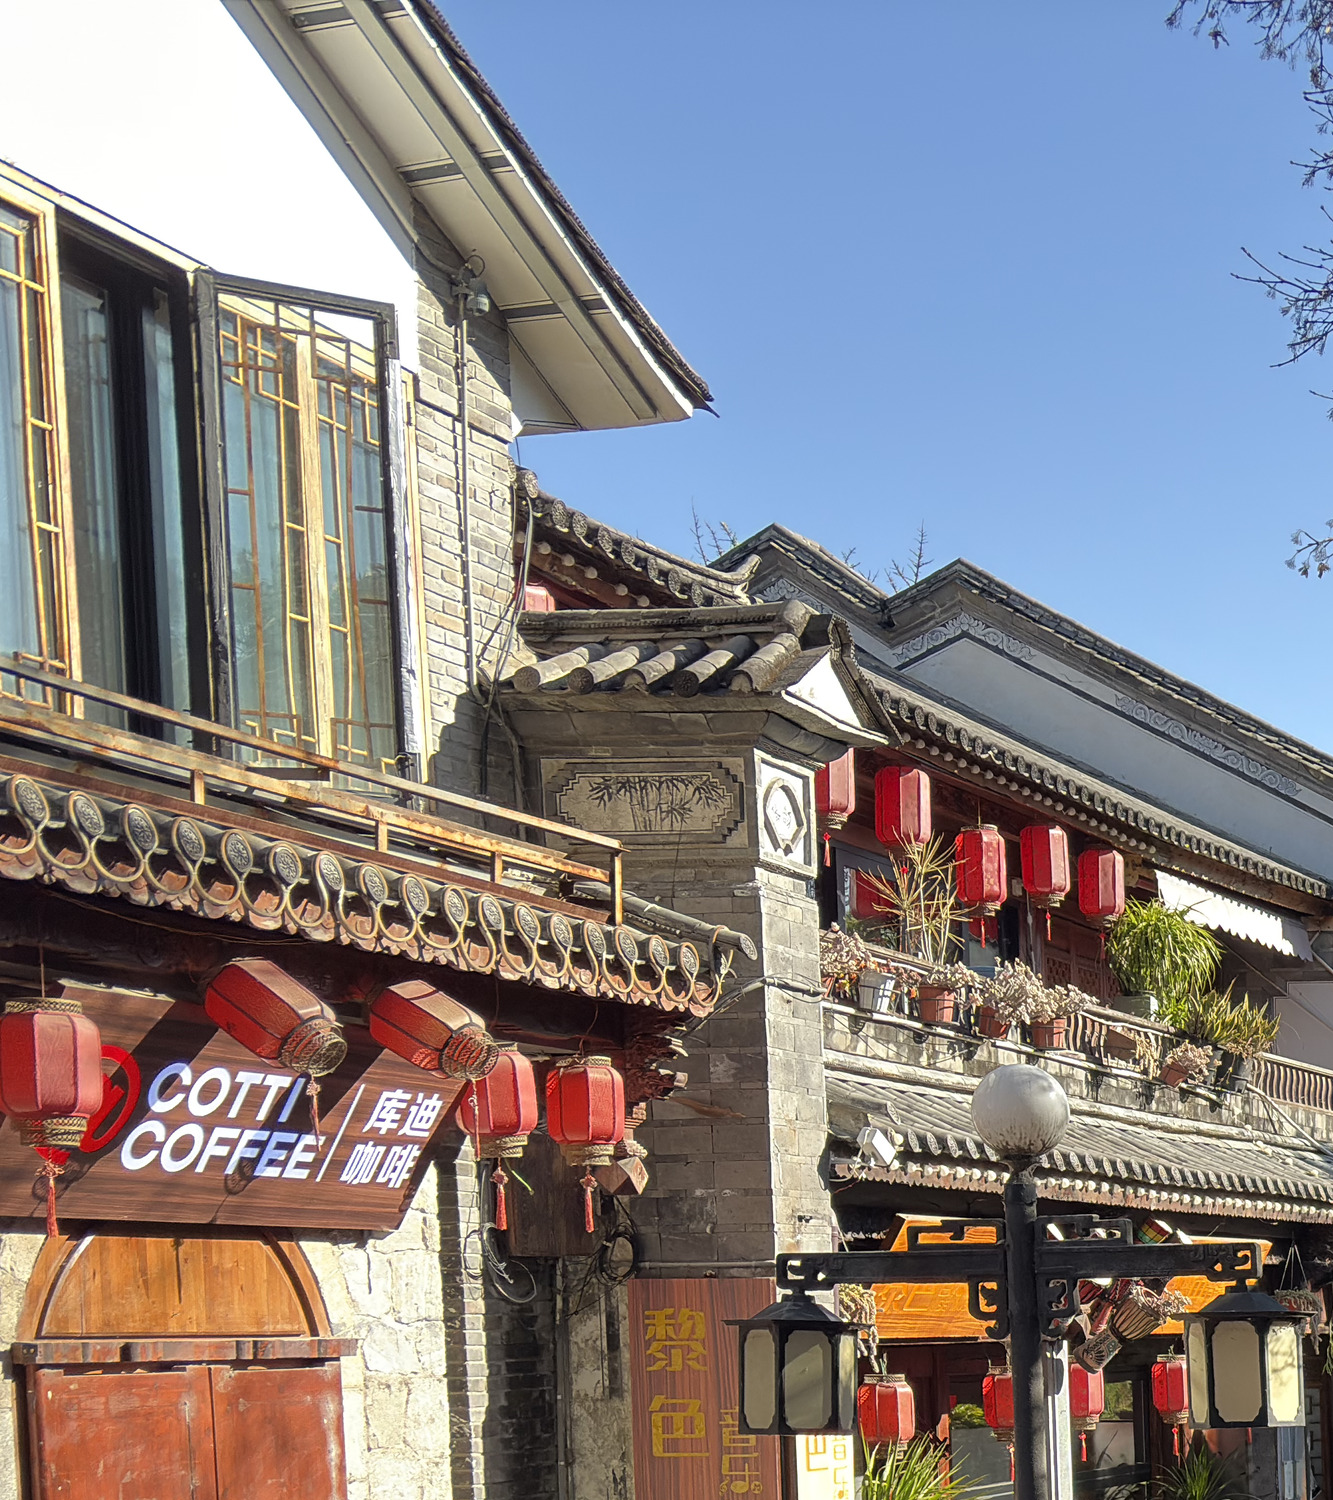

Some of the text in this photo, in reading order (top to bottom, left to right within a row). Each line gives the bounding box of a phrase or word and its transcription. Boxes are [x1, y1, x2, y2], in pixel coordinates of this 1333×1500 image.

[148, 1062, 305, 1122] COTTI
[362, 1089, 442, 1137] 库迪
[121, 1120, 324, 1179] COFFEE
[340, 1141, 421, 1189] 咖啡
[644, 1308, 710, 1457] 黎色
